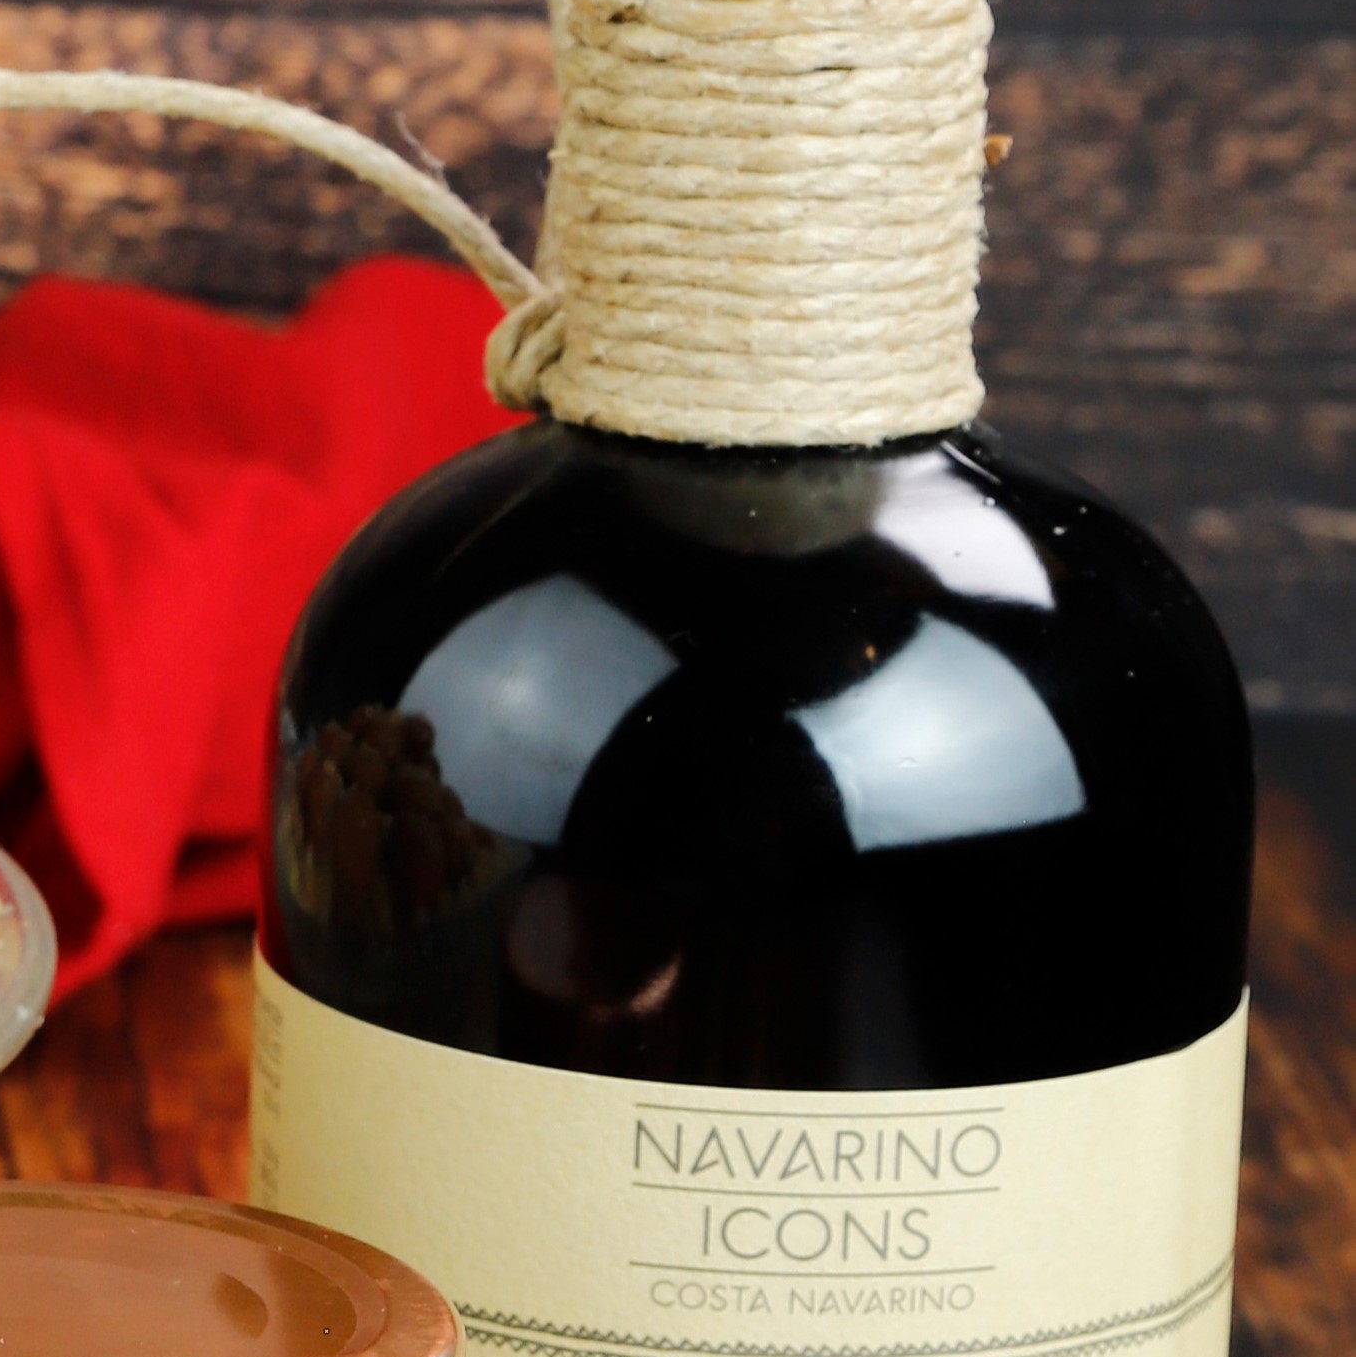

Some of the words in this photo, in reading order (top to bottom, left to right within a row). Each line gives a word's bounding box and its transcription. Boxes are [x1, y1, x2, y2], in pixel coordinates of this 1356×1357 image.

[635, 1120, 1001, 1181] NAVARINO
[703, 1205, 931, 1261] ICONS
[650, 1279, 772, 1313] COSTA
[789, 1283, 975, 1315] NAVARINO
